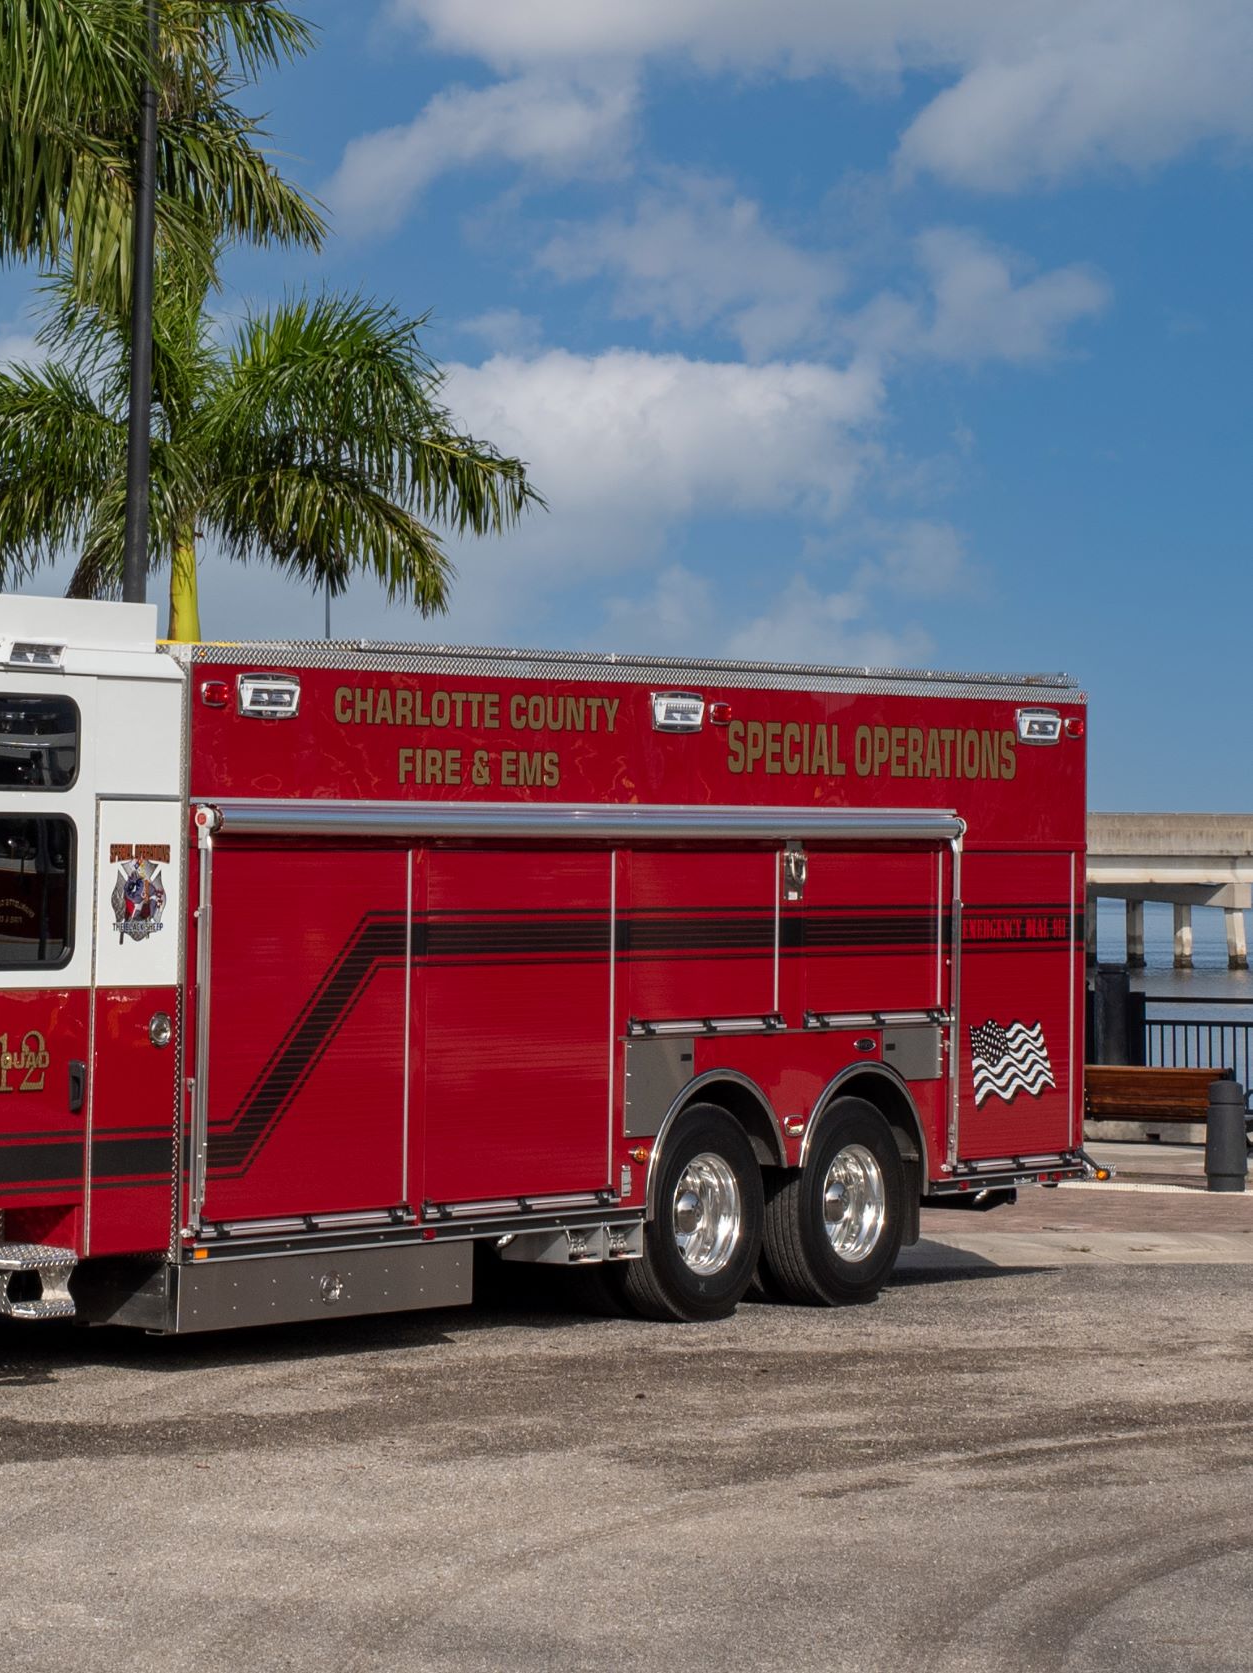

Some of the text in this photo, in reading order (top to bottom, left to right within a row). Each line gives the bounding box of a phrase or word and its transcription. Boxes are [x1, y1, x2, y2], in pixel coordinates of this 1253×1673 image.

[334, 686, 620, 732] CHARLOTTE COUNTY
[398, 748, 561, 787] FIRE & EMS
[727, 720, 1018, 780] SPECIAL OPERATIONS
